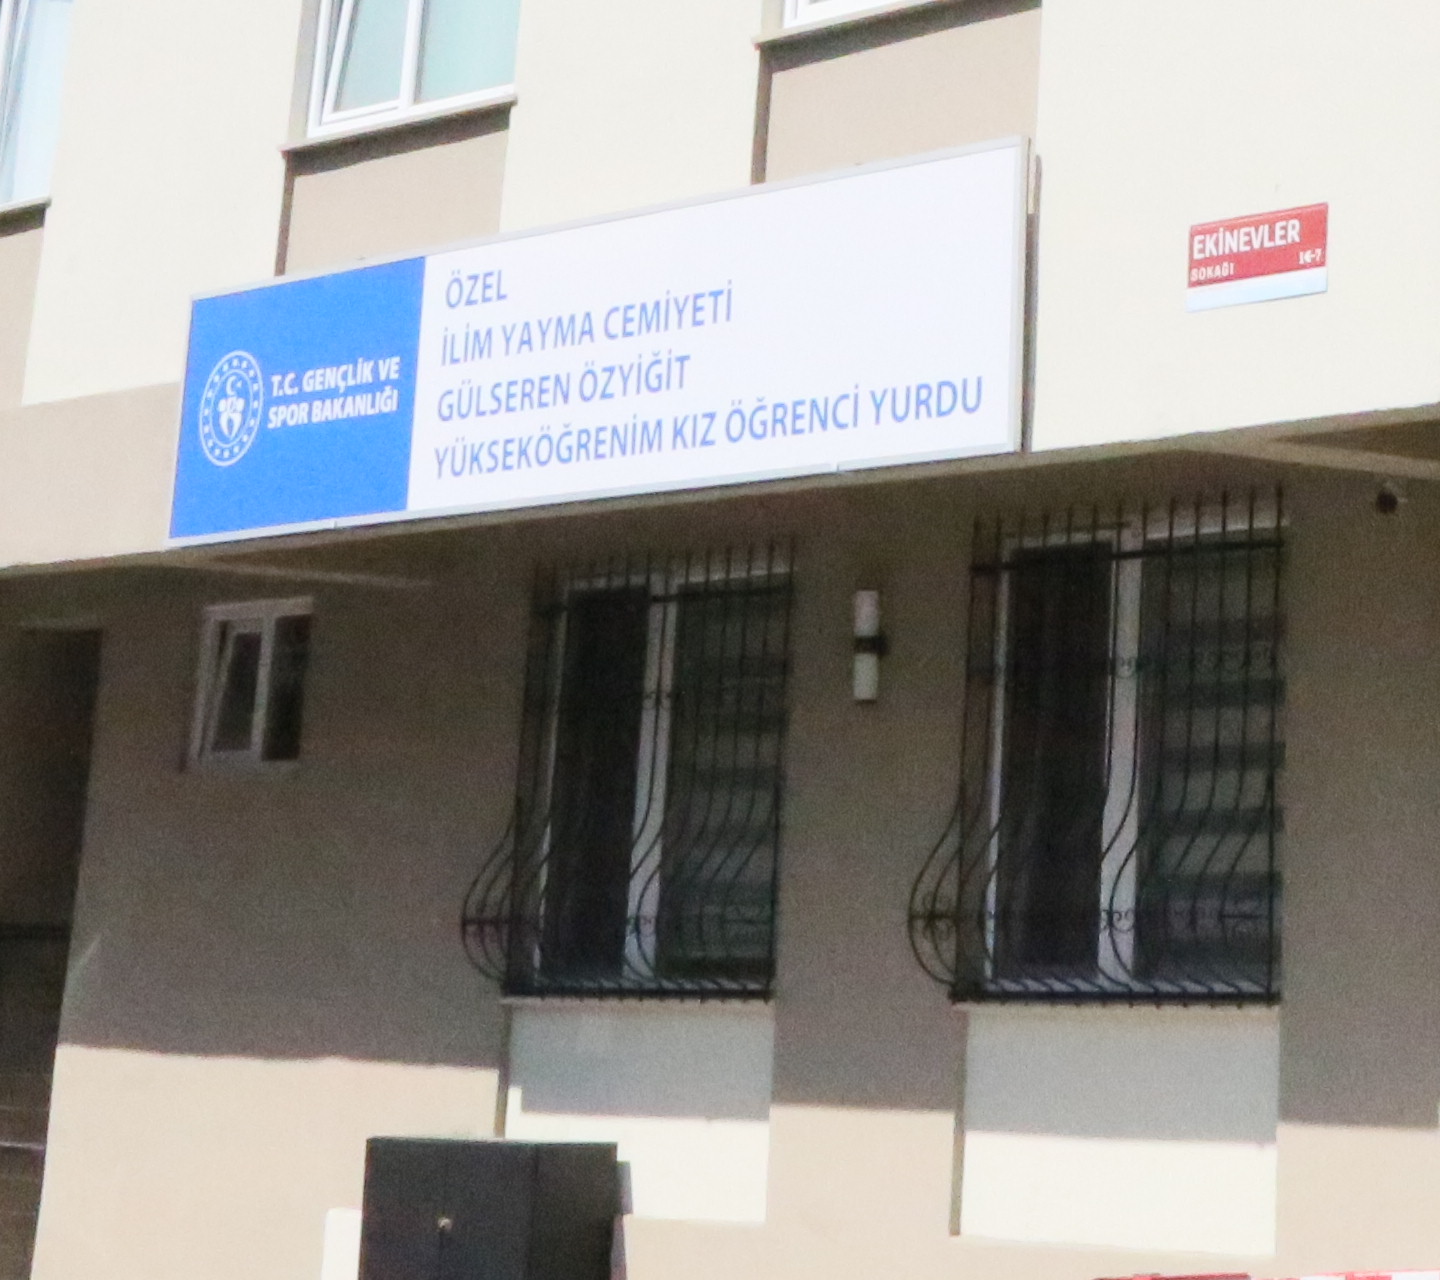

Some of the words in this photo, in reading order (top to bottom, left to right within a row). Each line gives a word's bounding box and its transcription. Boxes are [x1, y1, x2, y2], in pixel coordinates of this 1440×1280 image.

[1193, 219, 1300, 260] EKİNEVLER
[445, 269, 508, 310] ÖZEL
[1190, 261, 1235, 282] SOKAĞI
[440, 322, 493, 366] İLİM
[501, 311, 596, 357] YAYMA
[603, 279, 733, 341] CEMİYETİ
[271, 372, 299, 397] T.C.
[302, 357, 374, 393] GENÇLİK
[378, 356, 401, 381] VE
[437, 371, 571, 422] GÜLSEREN
[578, 348, 691, 403] ÖZYİĞİT
[267, 402, 308, 429] SPOR
[311, 385, 400, 423] BAKANLIĞI
[433, 413, 663, 480] YÜKSEKÖĞRENİM
[671, 411, 717, 451] KIZ
[725, 383, 859, 443] ÖĞRENCİ
[870, 376, 983, 425] YURDU
